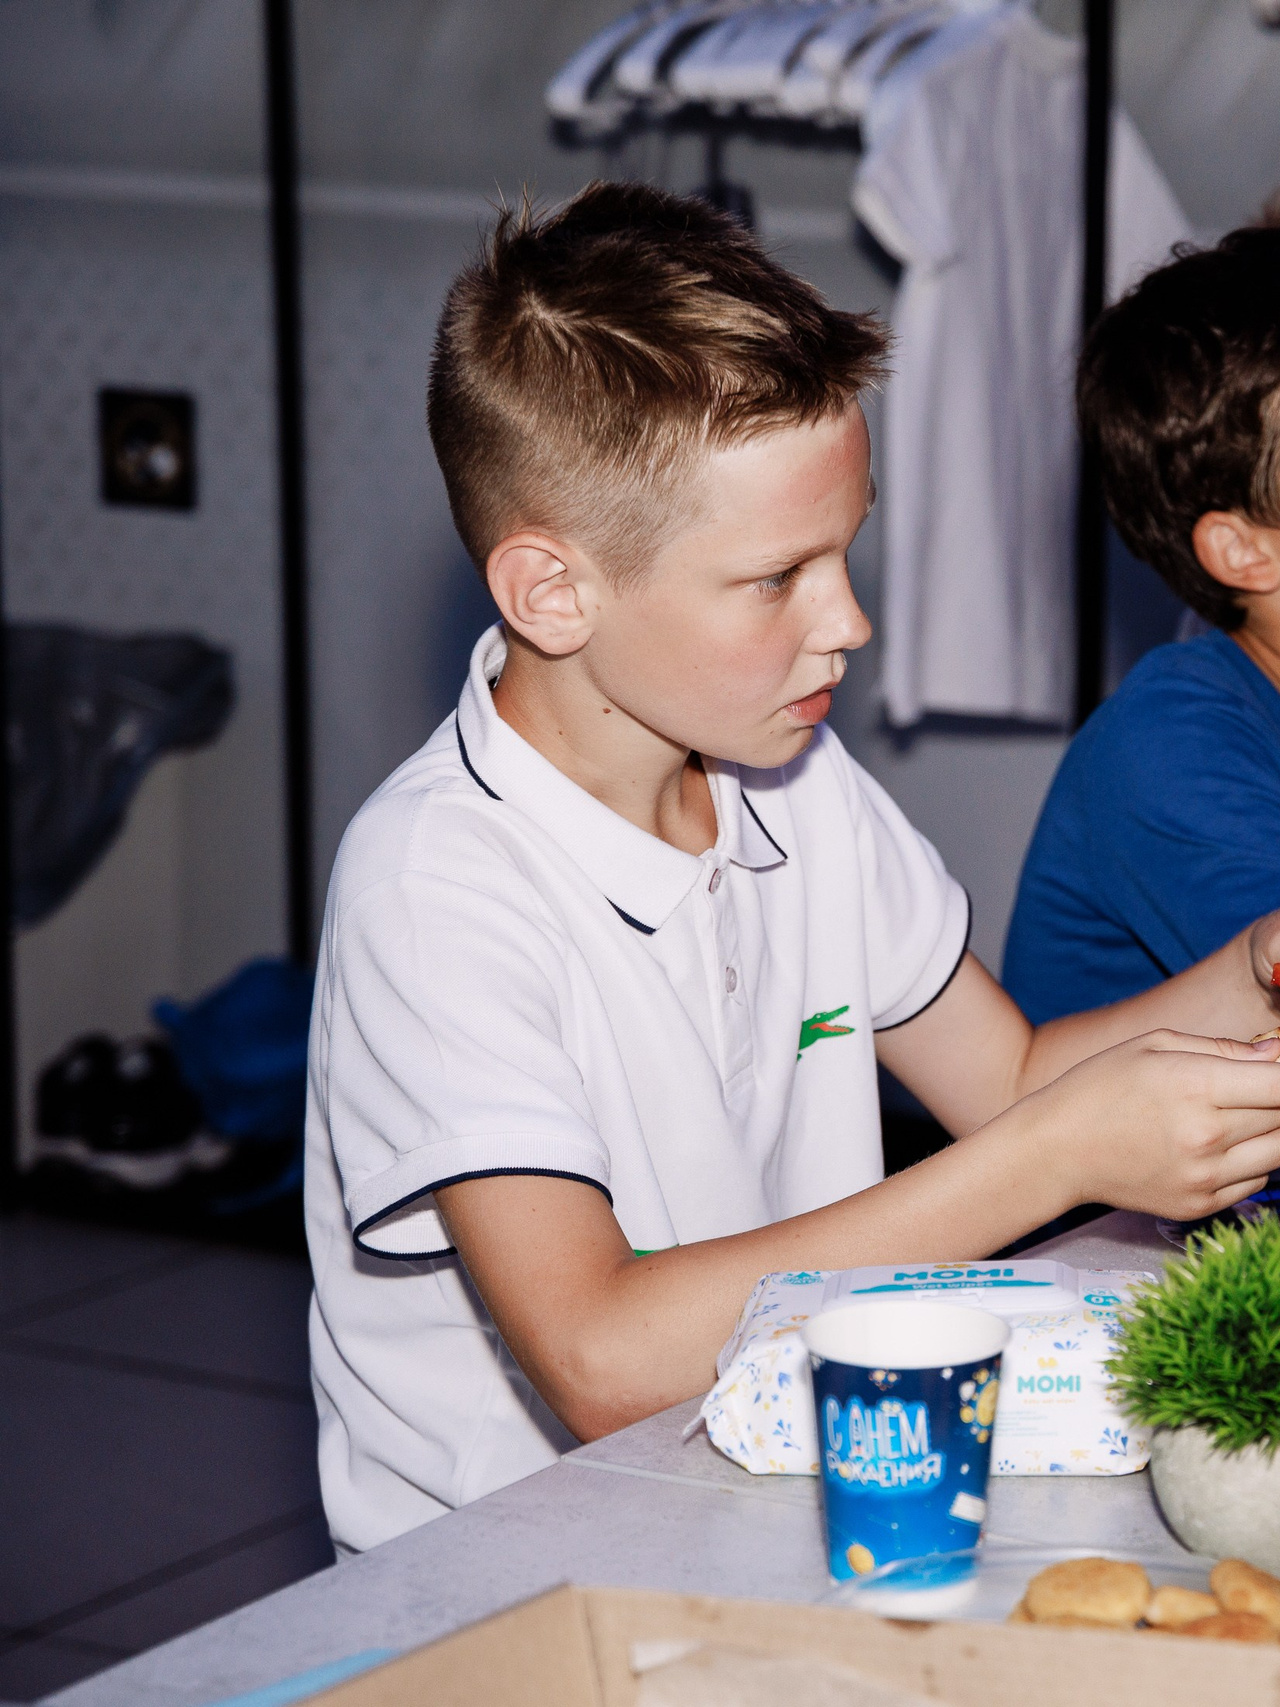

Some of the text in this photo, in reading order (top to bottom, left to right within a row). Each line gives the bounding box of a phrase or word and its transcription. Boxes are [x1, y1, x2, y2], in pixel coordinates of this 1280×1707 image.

[894, 1268, 1014, 1281] MOMI
[1017, 1375, 1081, 1393] MOMI
[826, 1398, 843, 1452] С
